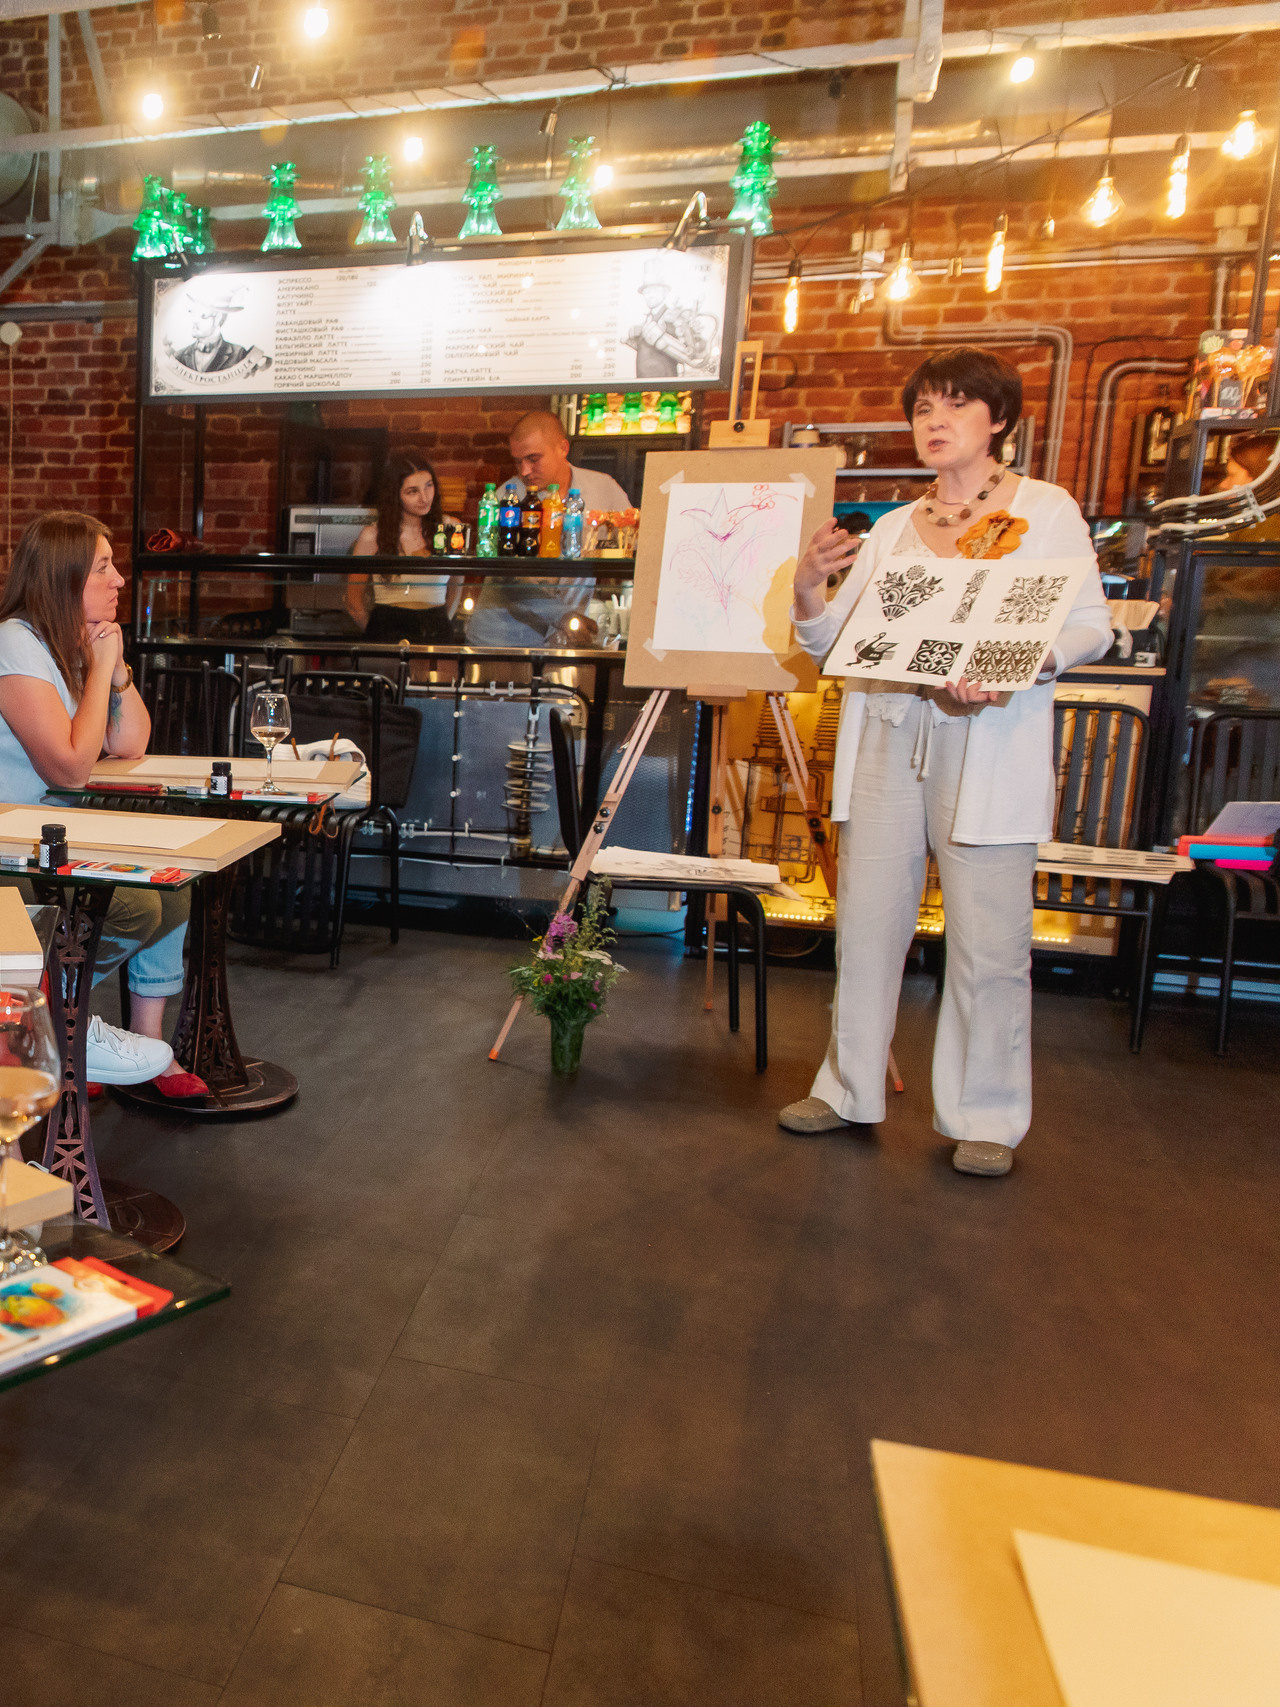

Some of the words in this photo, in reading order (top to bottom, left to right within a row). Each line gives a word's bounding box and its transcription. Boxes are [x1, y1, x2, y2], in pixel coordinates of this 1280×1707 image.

[276, 319, 323, 327] ЛАВАНДОВЫЙ
[276, 326, 328, 334] ФИСТАШКОВЫЙ
[275, 334, 311, 342] РАФАЭЛЛО
[275, 342, 323, 350] БЕЛЬГИЙСКИЙ
[275, 350, 314, 358] ИМБИРНЫЙ
[274, 357, 308, 365] МЕДОВЫЙ
[310, 356, 338, 364] МАСАЛА
[274, 365, 316, 373] ФРАПУЧИНО
[274, 381, 305, 389] ГОРЯЧИЙ
[306, 379, 341, 387] ШОКОЛАД
